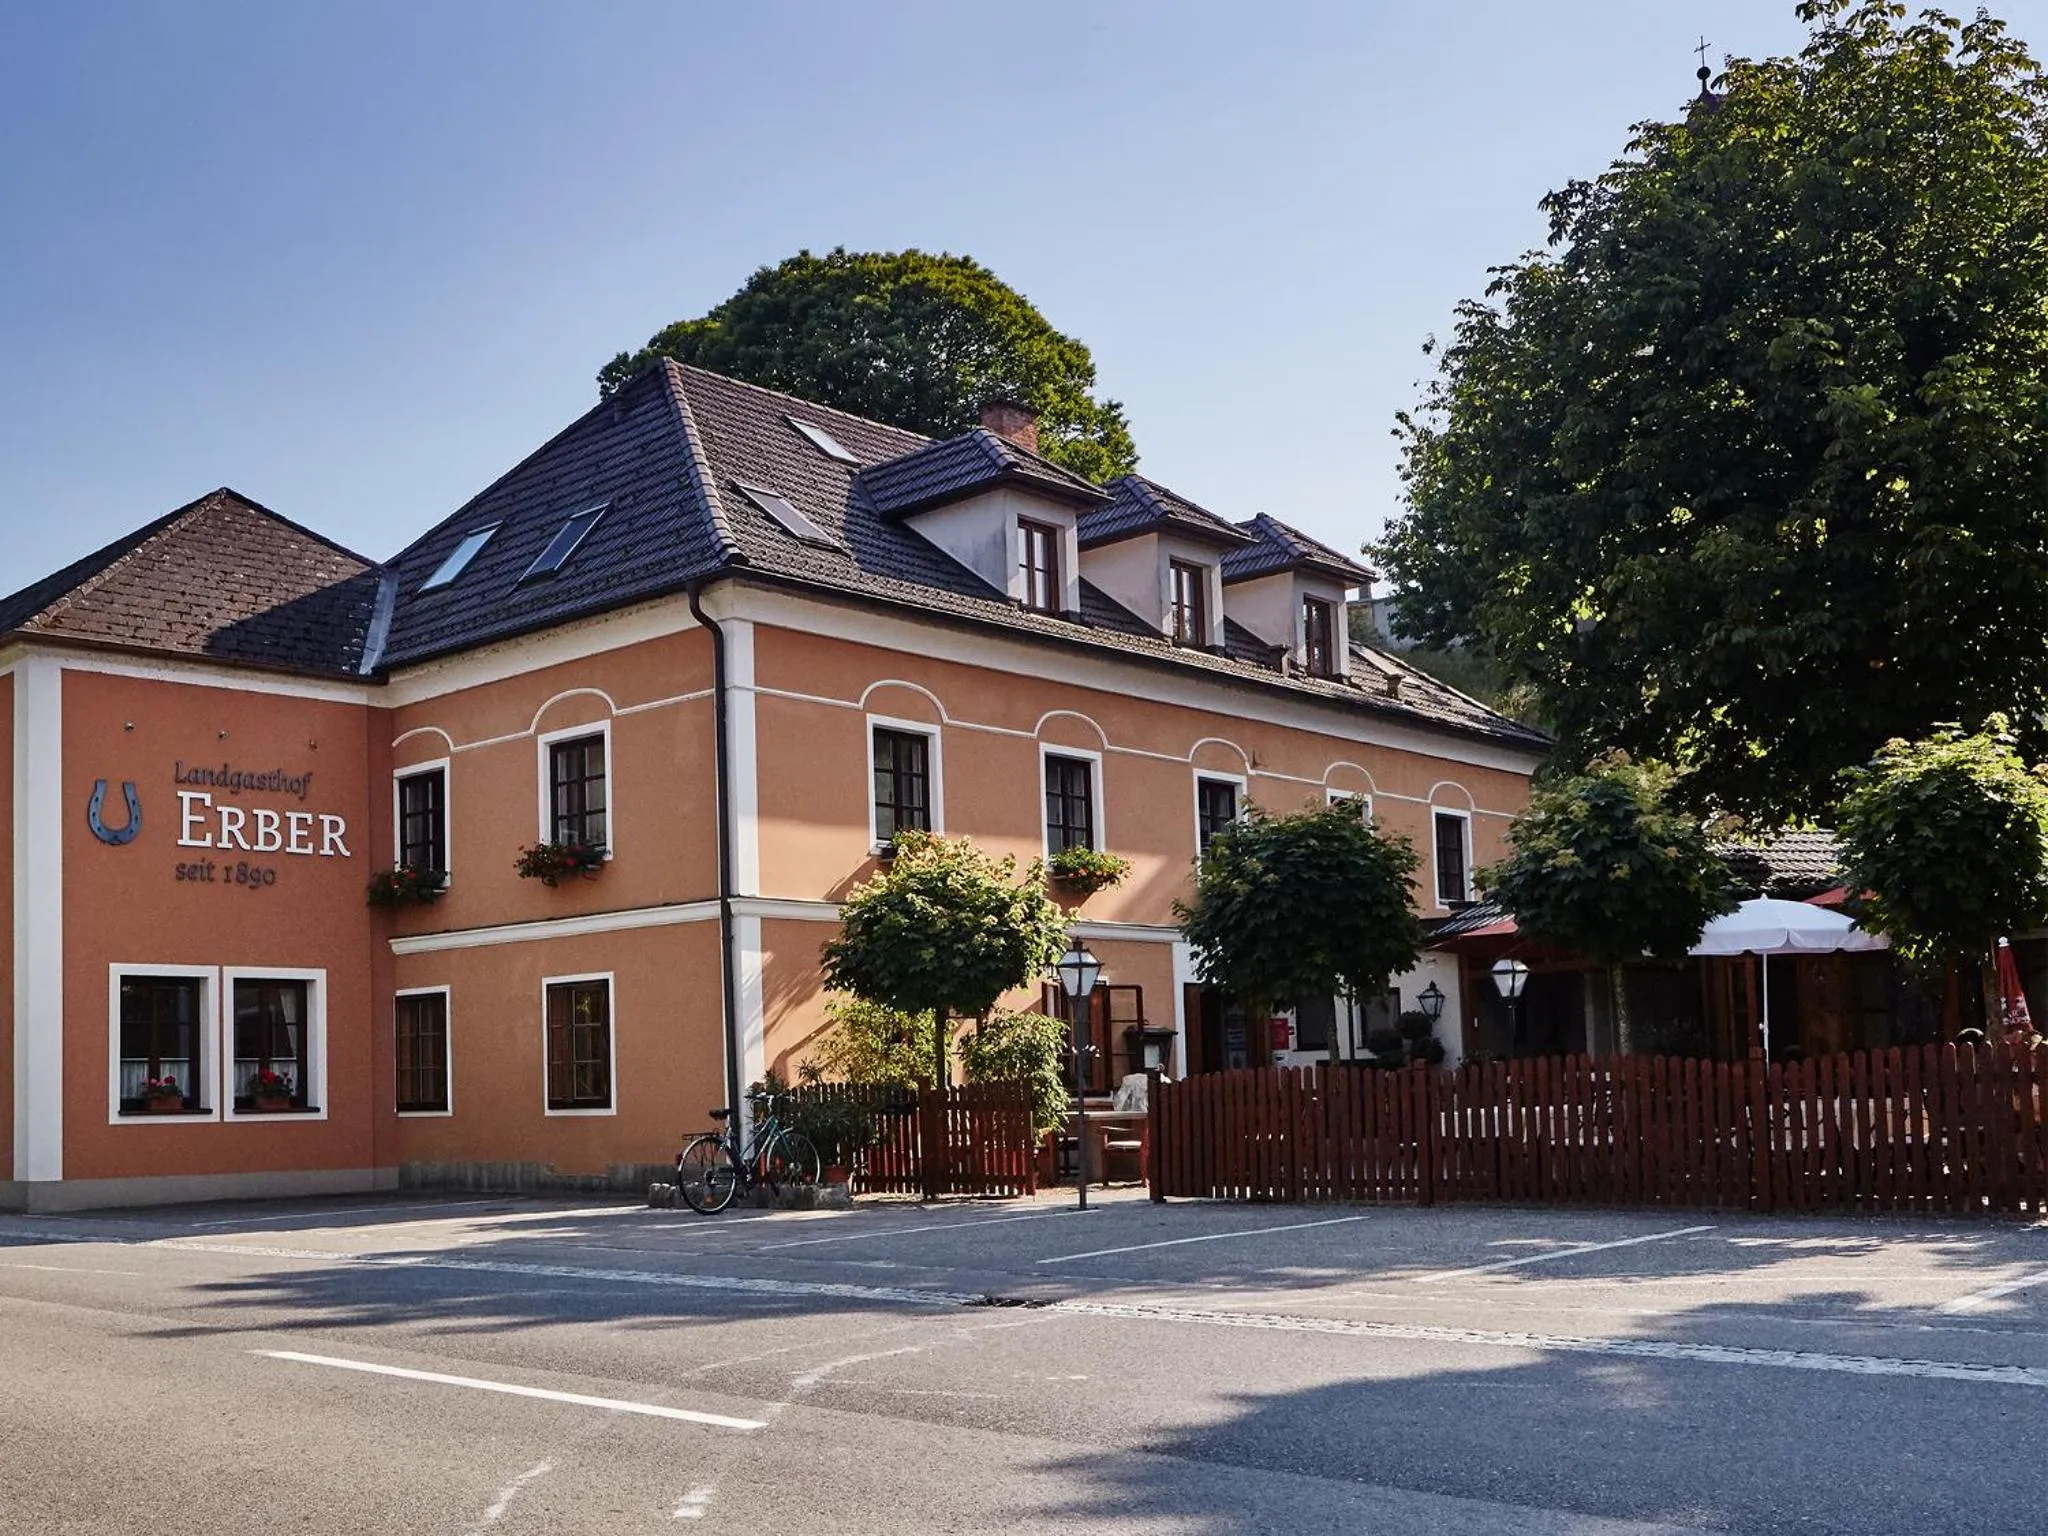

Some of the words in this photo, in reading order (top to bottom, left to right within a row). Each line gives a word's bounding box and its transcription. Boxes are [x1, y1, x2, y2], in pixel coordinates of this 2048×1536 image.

[175, 760, 313, 801] Landgasthof
[177, 791, 351, 857] ERBER
[175, 858, 216, 883] seit
[223, 861, 276, 889] 1890
